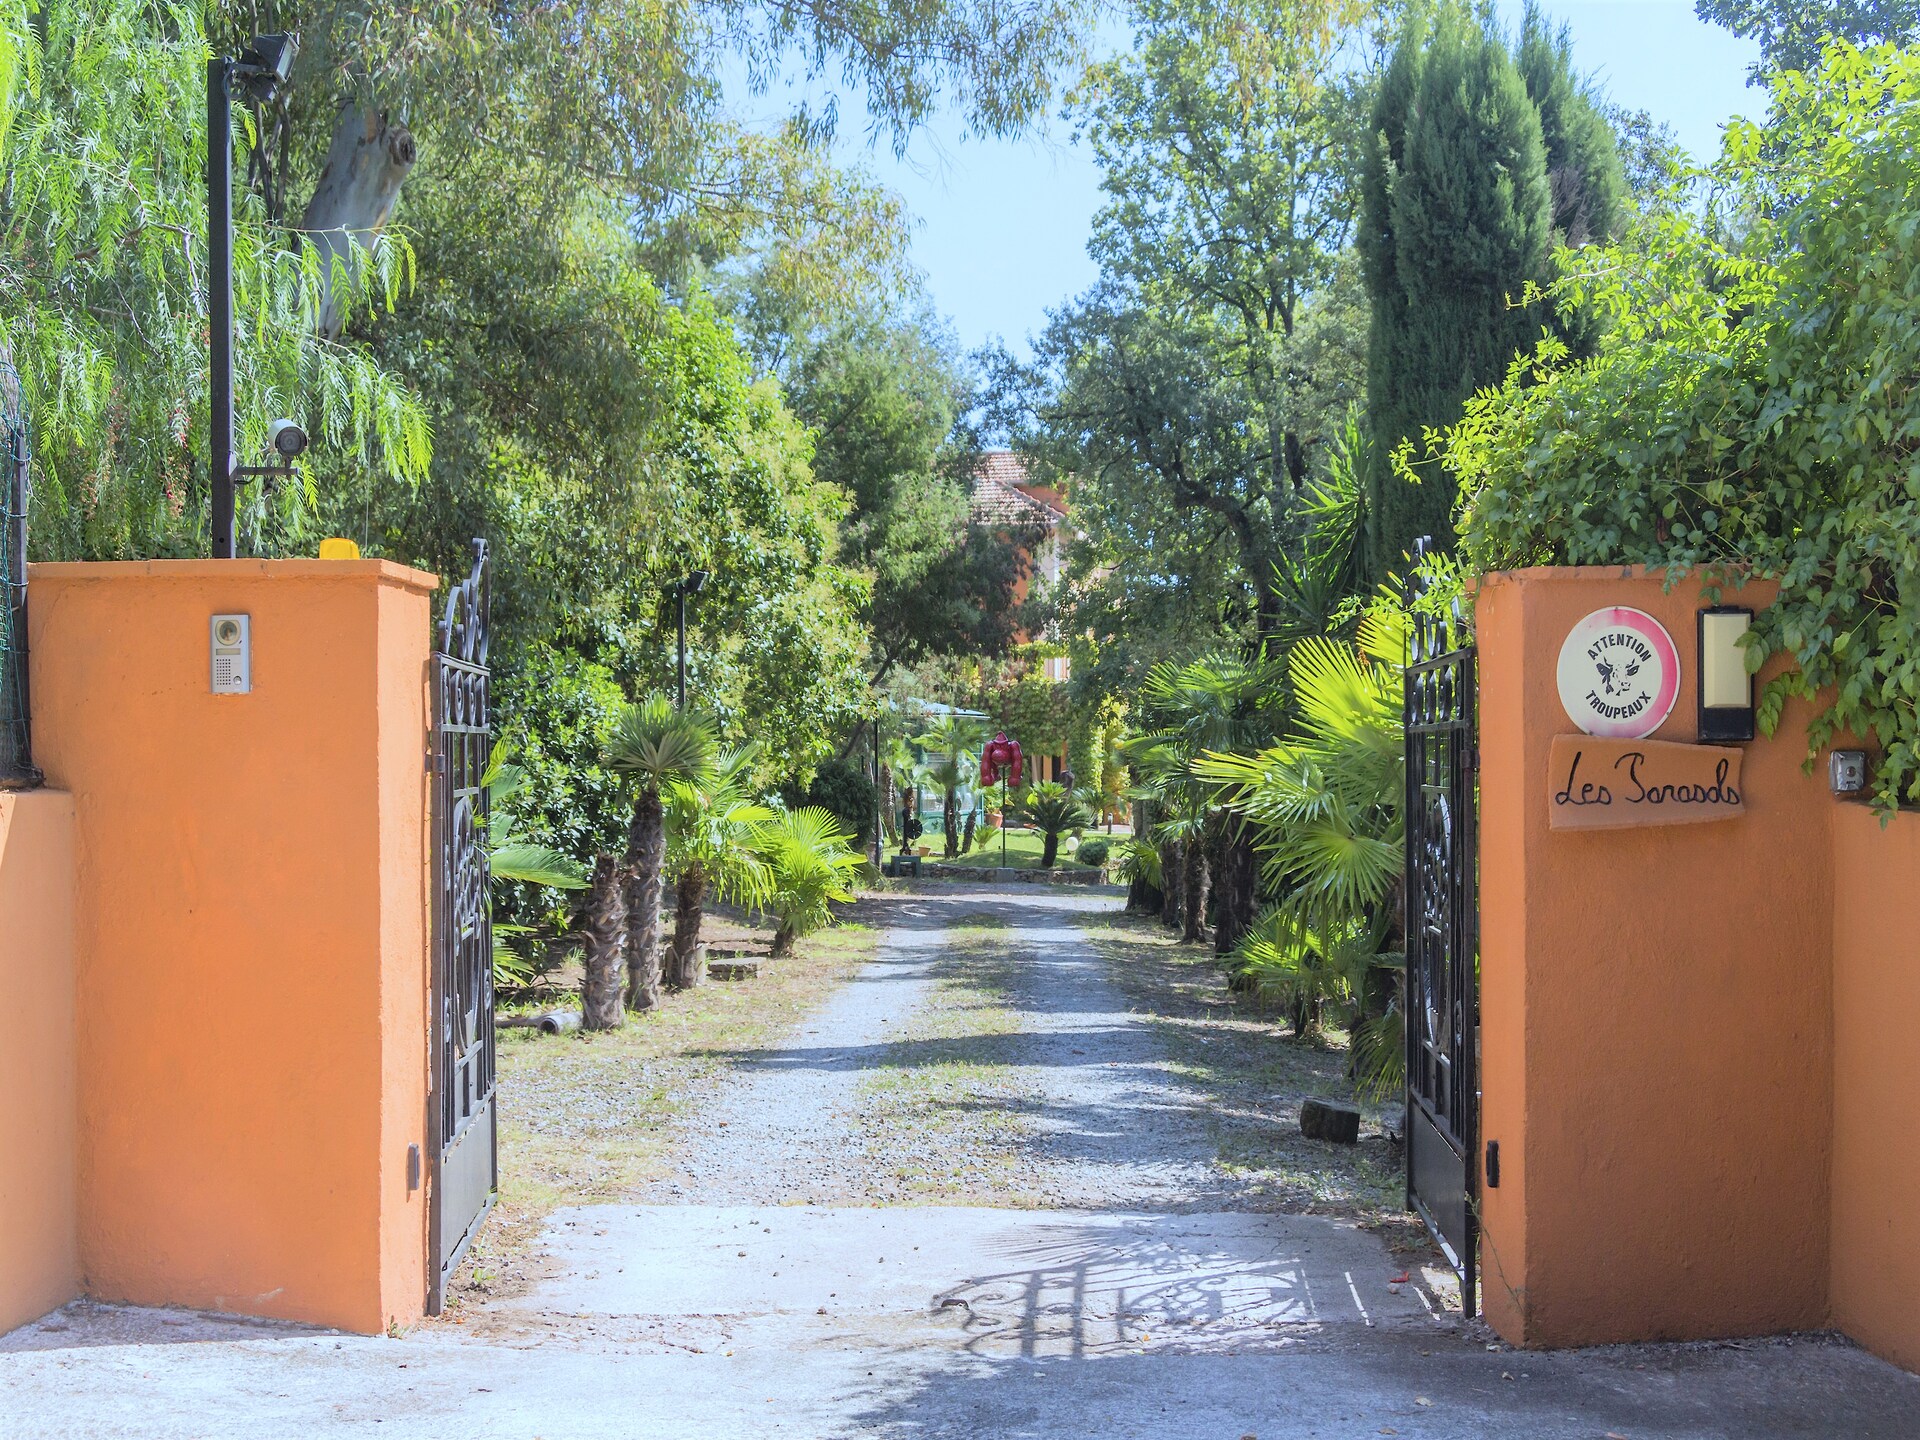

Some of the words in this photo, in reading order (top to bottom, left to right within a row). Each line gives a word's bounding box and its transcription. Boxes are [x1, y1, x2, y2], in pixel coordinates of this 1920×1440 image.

[1587, 633, 1651, 661] ATTENTION
[1585, 689, 1652, 719] TROUPEAUX
[1555, 751, 1612, 805] Les
